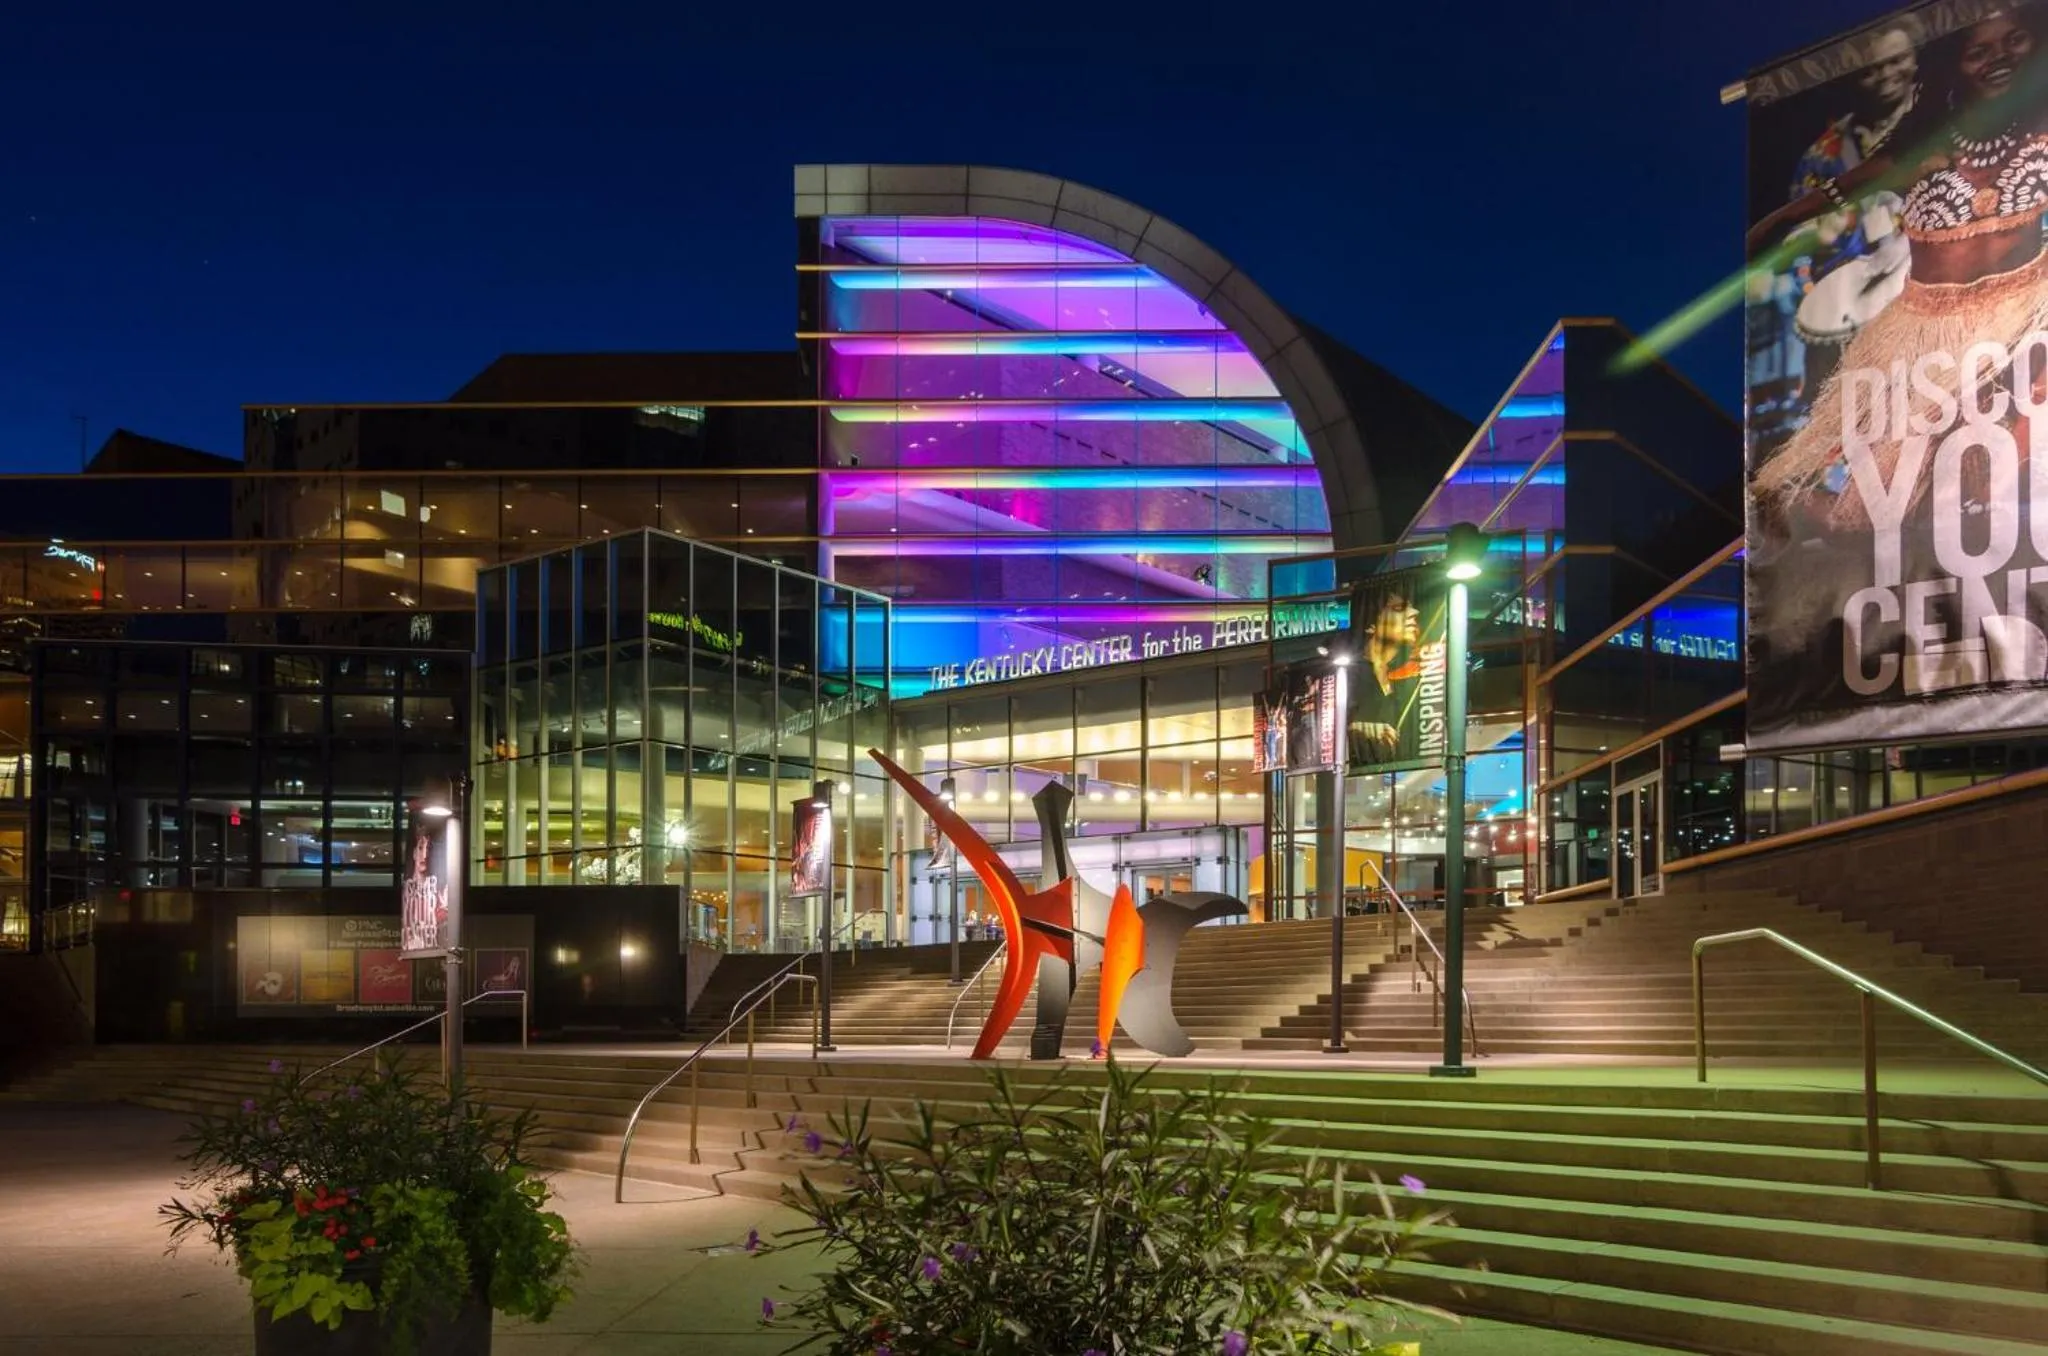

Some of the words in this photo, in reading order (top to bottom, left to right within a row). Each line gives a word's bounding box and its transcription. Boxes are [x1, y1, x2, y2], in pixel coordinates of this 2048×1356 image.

[1846, 414, 2048, 588] YO
[928, 664, 959, 690] THE
[964, 647, 1056, 686] KENTUCKY
[1060, 634, 1132, 670] CENTER
[1142, 632, 1169, 658] for
[1172, 625, 1203, 652] the
[1212, 601, 1339, 649] PERFORMING
[1320, 675, 1335, 765] ELECTRIFYING
[1419, 640, 1446, 757] INSPIRING
